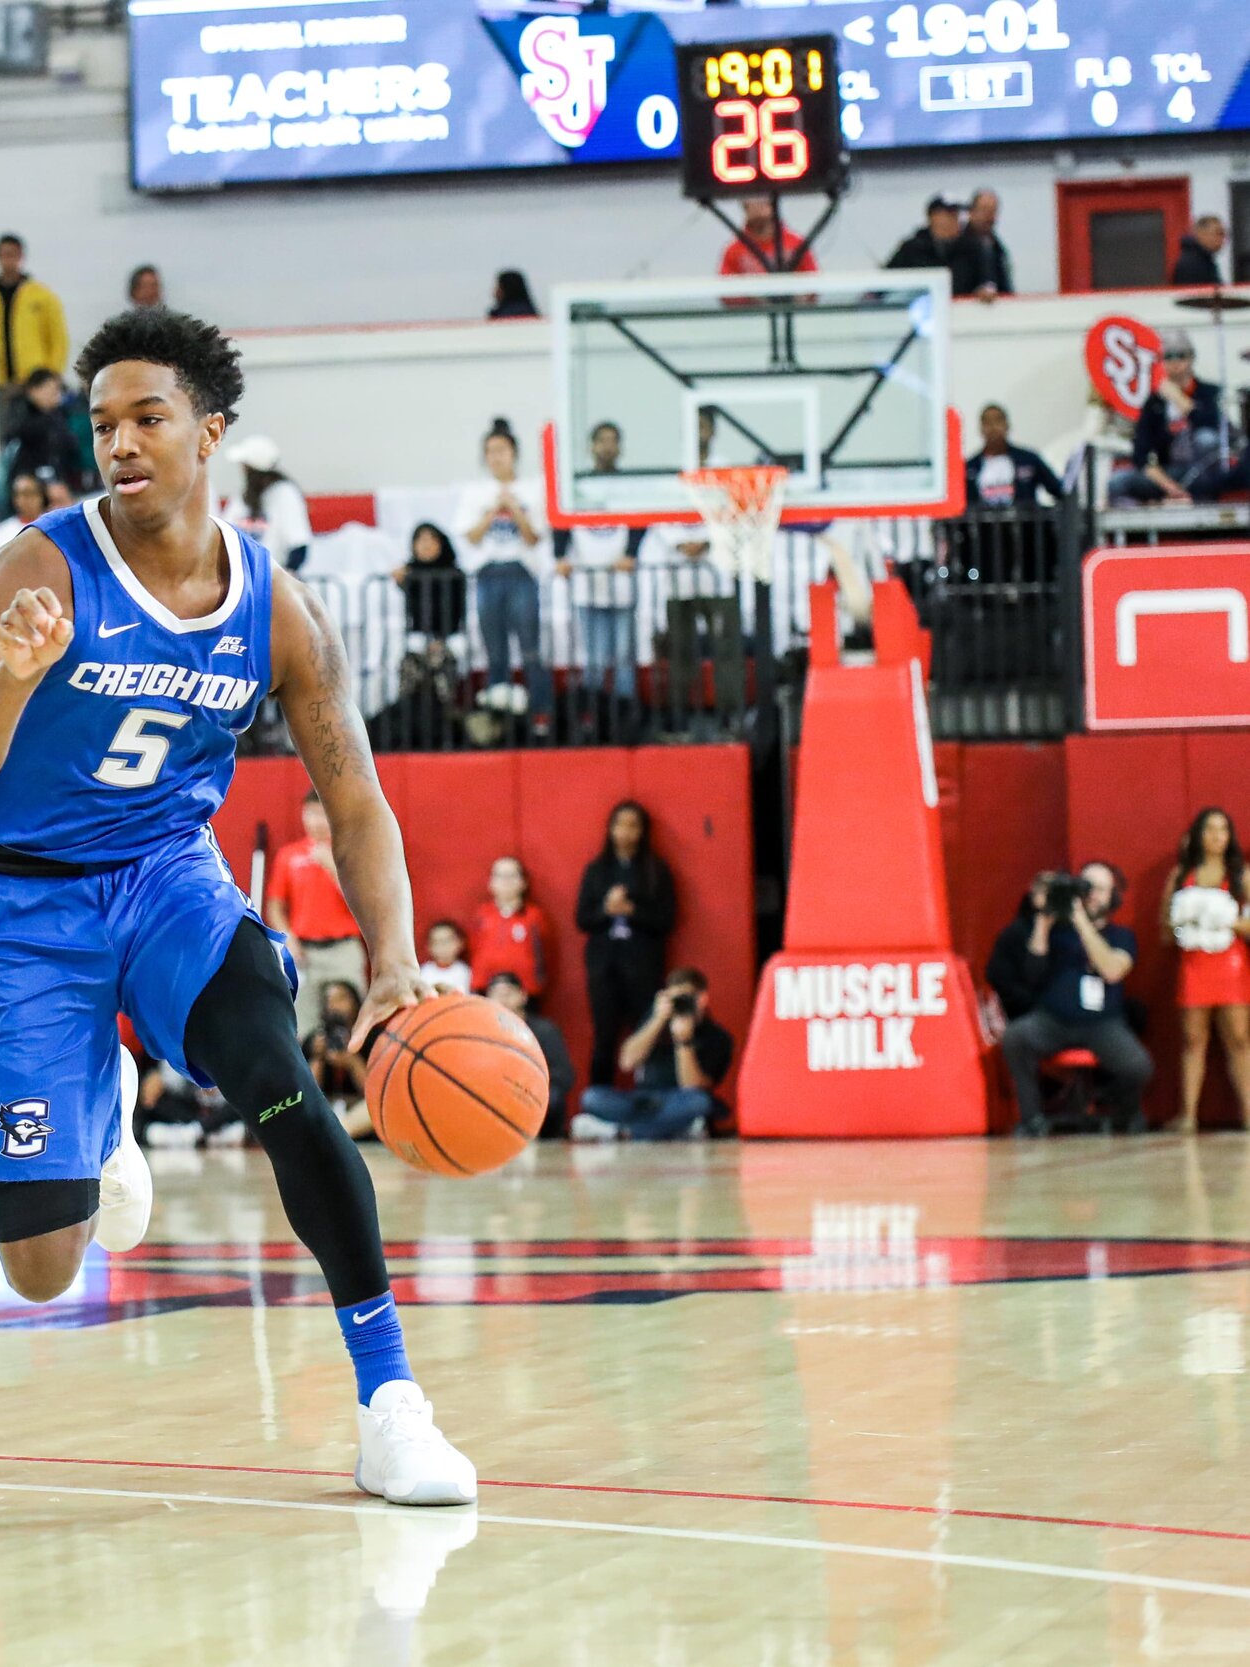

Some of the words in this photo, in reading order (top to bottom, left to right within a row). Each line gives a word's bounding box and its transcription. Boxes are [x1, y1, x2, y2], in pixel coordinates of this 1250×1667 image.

[886, 0, 1070, 58] 19:01
[161, 62, 451, 124] TEACHERS
[705, 48, 823, 98] 19:01
[637, 94, 678, 149] 0
[1167, 86, 1196, 123] 4
[712, 97, 809, 182] 26
[213, 643, 248, 654] EAST
[219, 635, 243, 645] BIG
[67, 661, 259, 711] CREIGHTON
[92, 707, 192, 789] 5
[774, 962, 948, 1020] MUSCLE
